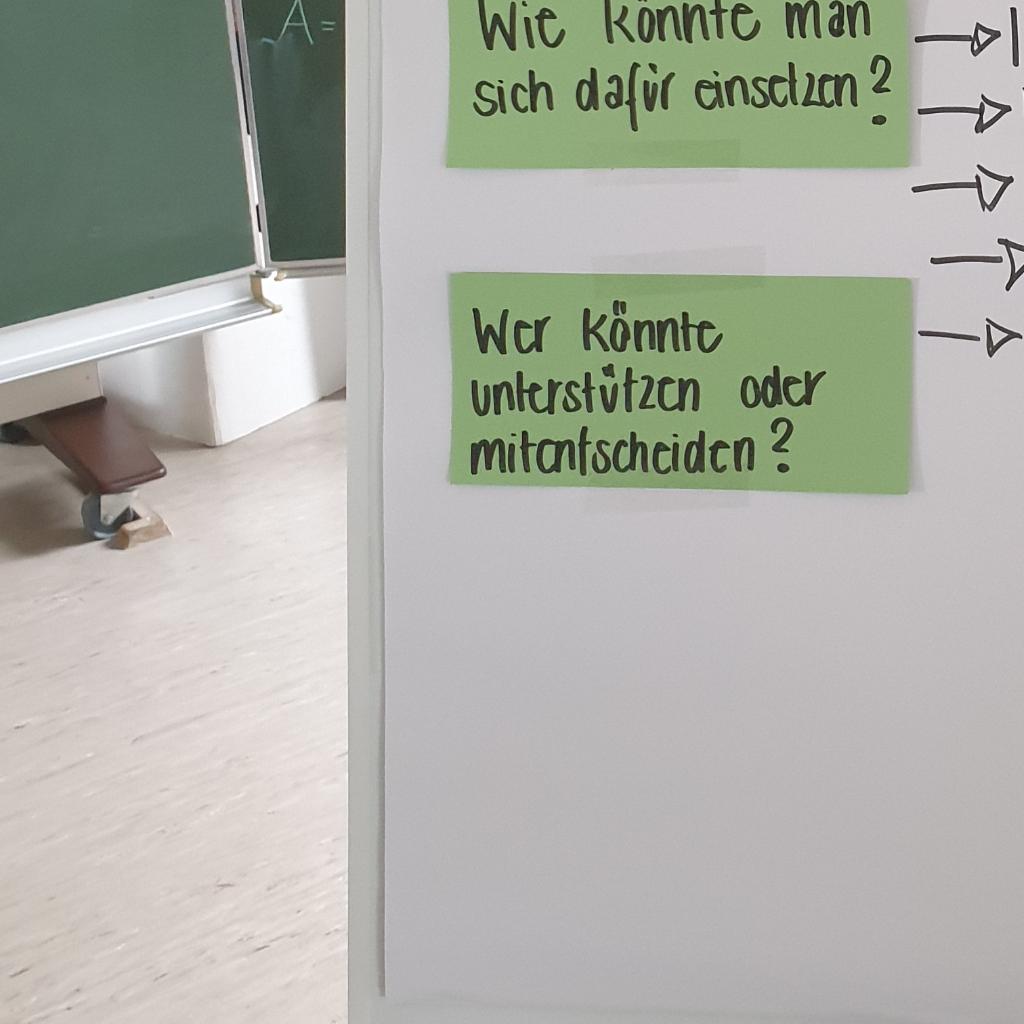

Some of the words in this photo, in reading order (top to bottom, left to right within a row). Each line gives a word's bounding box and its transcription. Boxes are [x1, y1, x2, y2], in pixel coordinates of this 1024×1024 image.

[785, 0, 871, 40] man
[472, 69, 555, 117] sich
[575, 63, 676, 133] dafür
[472, 307, 551, 356] Wer
[471, 363, 700, 416] unterstützen
[740, 366, 826, 409] oder
